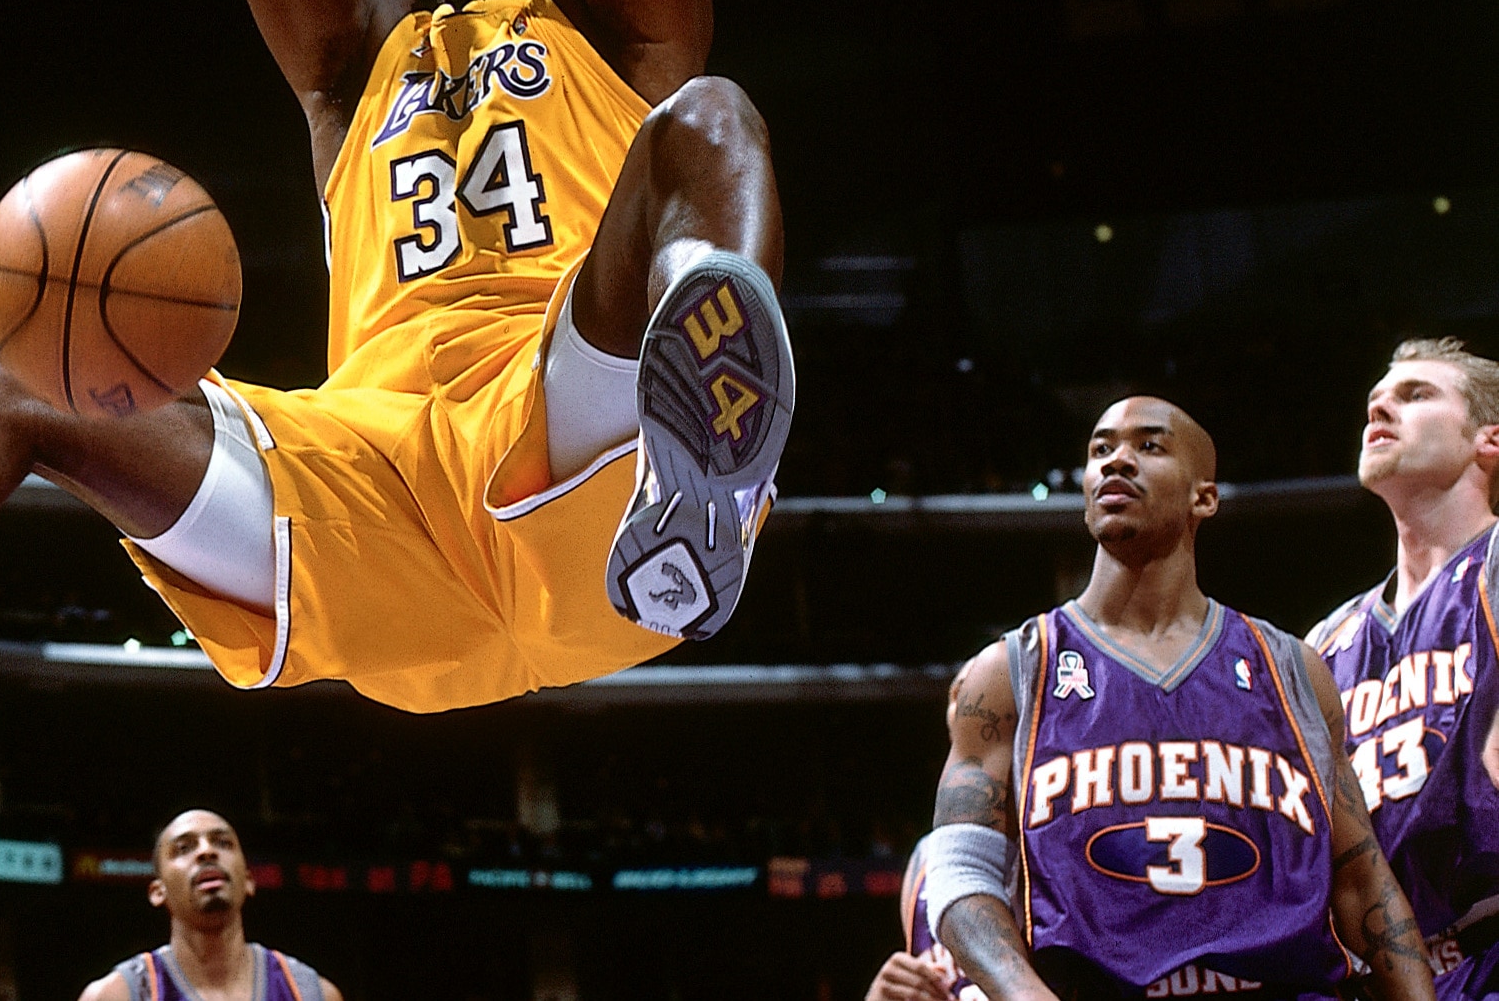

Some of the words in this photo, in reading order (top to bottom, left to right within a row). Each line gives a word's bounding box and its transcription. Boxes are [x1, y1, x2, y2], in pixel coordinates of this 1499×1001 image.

[370, 40, 552, 152] LAKERS
[390, 118, 553, 283] 34
[678, 276, 765, 445] 34
[1027, 739, 1316, 836] PHOENIX
[1349, 714, 1430, 814] 43
[1144, 815, 1207, 896] 3
